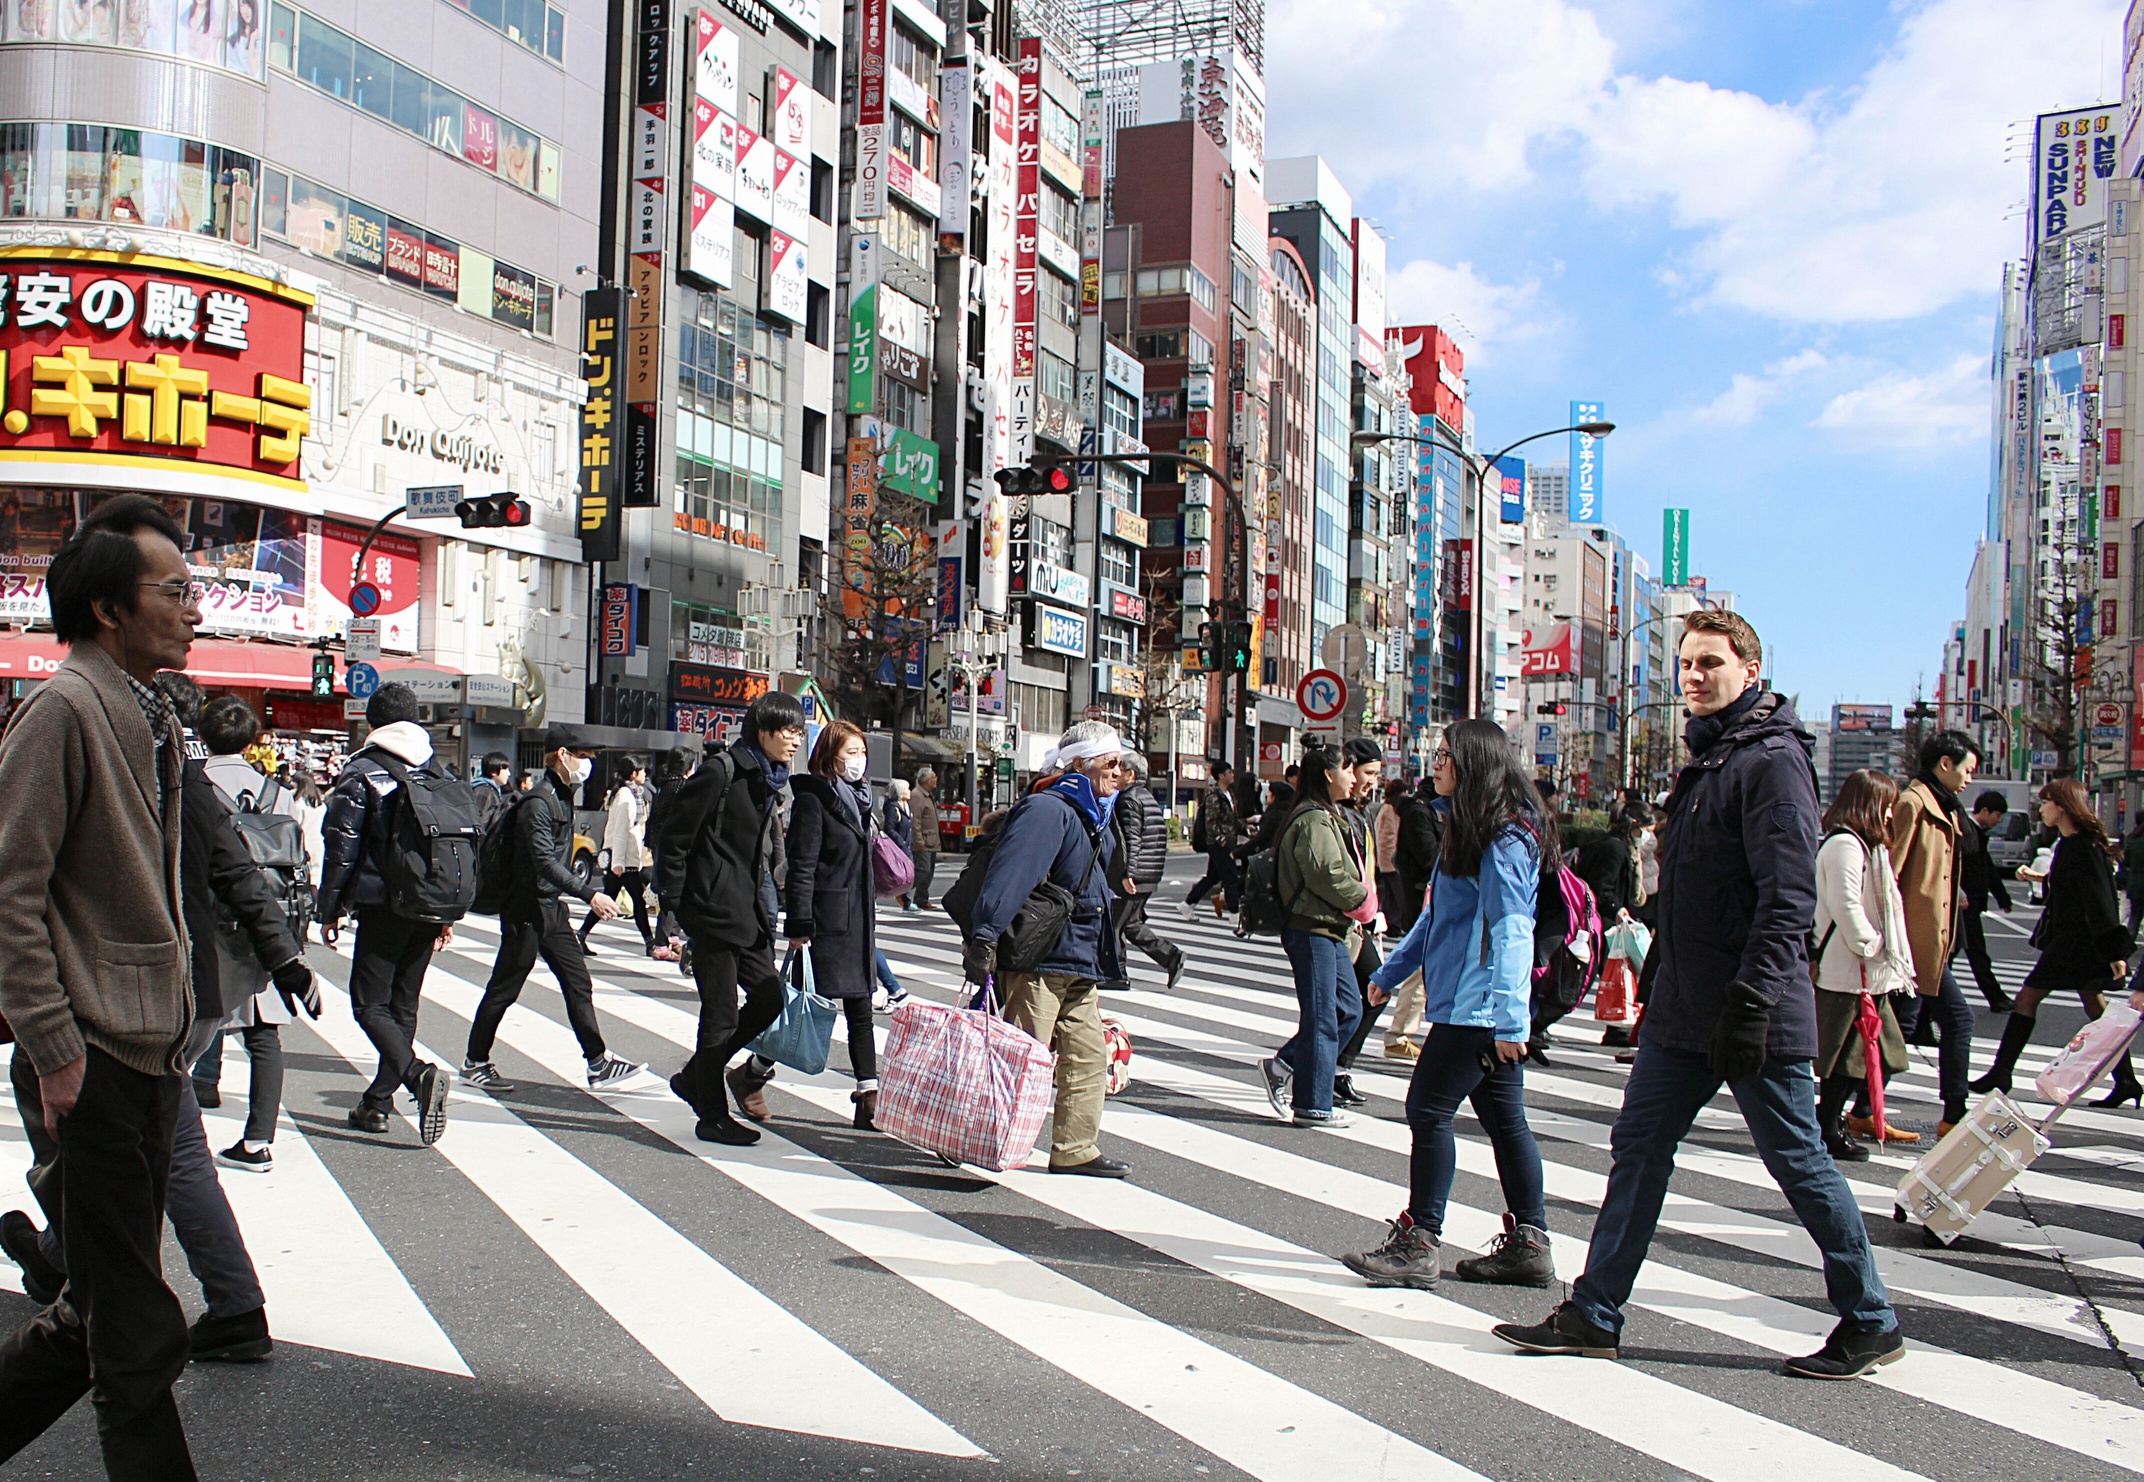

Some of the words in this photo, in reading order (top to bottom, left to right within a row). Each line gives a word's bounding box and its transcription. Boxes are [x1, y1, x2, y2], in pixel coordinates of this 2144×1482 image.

[648, 5, 662, 86] ロックアップ
[700, 17, 713, 36] 8F
[779, 73, 790, 91] 9F
[655, 106, 665, 115] 5F
[697, 104, 711, 122] 4F
[1017, 55, 1038, 161] カラオケ
[644, 120, 656, 170] 手羽一郎
[738, 129, 750, 147] 5F
[862, 126, 881, 137] 全品
[697, 141, 733, 175] 北の家族
[776, 154, 788, 171] 6F
[2074, 140, 2087, 206] SHINJUKU
[2093, 135, 2116, 178] NEW
[693, 191, 706, 210] B1
[2045, 143, 2069, 238] SUNPARK
[347, 213, 382, 252] 販売
[642, 192, 654, 244] 北の家族
[388, 215, 421, 262] ブランド
[694, 231, 731, 262] ミステリアス
[773, 236, 786, 253] 2F
[1016, 193, 1038, 295] パセラ
[426, 250, 457, 272] 時計
[0, 272, 249, 350] 安の殿堂
[782, 295, 800, 312] ロック
[638, 270, 651, 383] アラビアンロック
[1014, 328, 1024, 360] ハニトー
[1024, 331, 1033, 351] 名物
[853, 321, 870, 374] レイク
[382, 412, 426, 452] Don
[582, 317, 614, 531] ドン・キホーテ
[634, 425, 644, 493] ミステリアス
[895, 442, 934, 485] レイク
[1081, 430, 1094, 474] 747
[1397, 449, 1405, 488] TSUTAYA
[851, 462, 860, 490] セット
[862, 458, 870, 486] フリー
[1578, 431, 1595, 521] サキクリニック
[411, 490, 459, 505] 歌舞伎町
[1011, 523, 1027, 574] ダーツ
[186, 566, 218, 578] ence
[943, 563, 956, 616] PROMISE
[1461, 550, 1470, 596] SHIDAX
[606, 586, 627, 601] 薬
[605, 602, 626, 654] ダイコク
[1393, 630, 1401, 669] TSUTAYA
[353, 671, 365, 693] P
[804, 697, 812, 708] P
[1539, 725, 1552, 742] P
[2033, 752, 2041, 763] P
